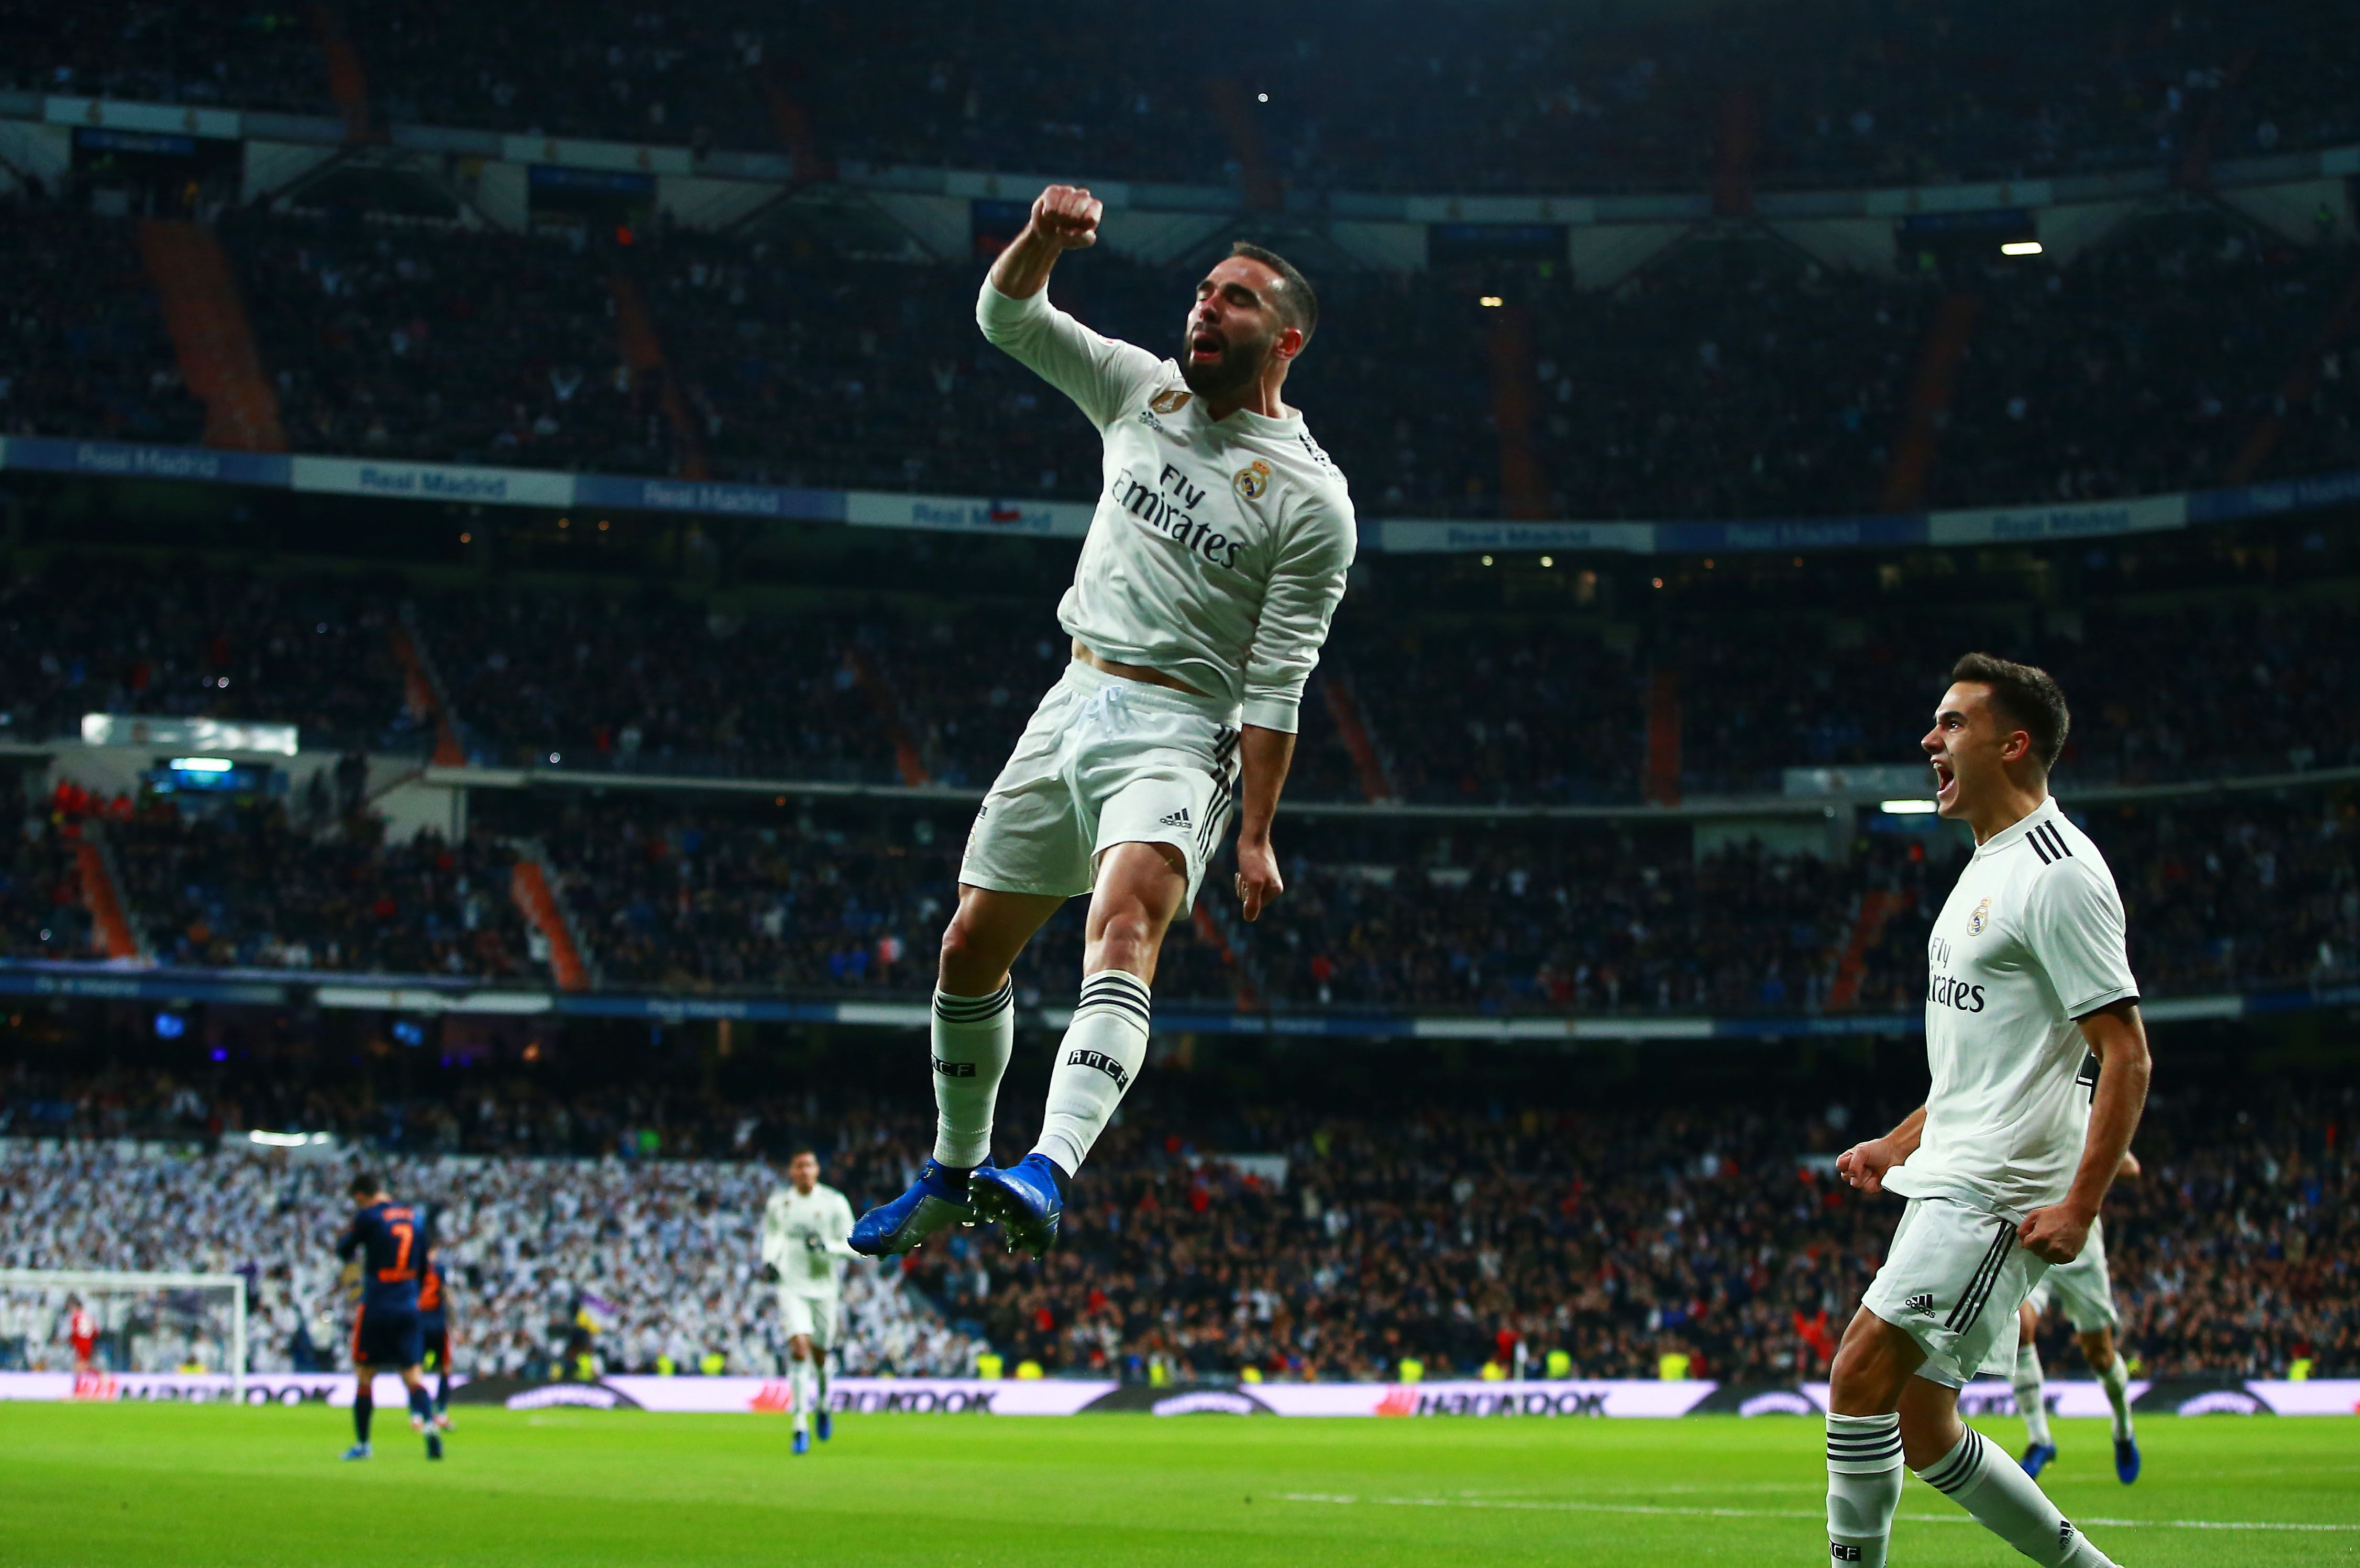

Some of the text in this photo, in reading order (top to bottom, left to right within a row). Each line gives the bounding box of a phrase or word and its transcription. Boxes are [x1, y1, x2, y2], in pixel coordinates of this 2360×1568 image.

[1160, 463, 1205, 509] Fly
[1112, 468, 1241, 569] Emirates
[1931, 936, 1951, 969] Fly
[1927, 964, 1984, 1013] irates
[1069, 1050, 1127, 1084] RMCF
[1905, 1299, 1936, 1318] adidas
